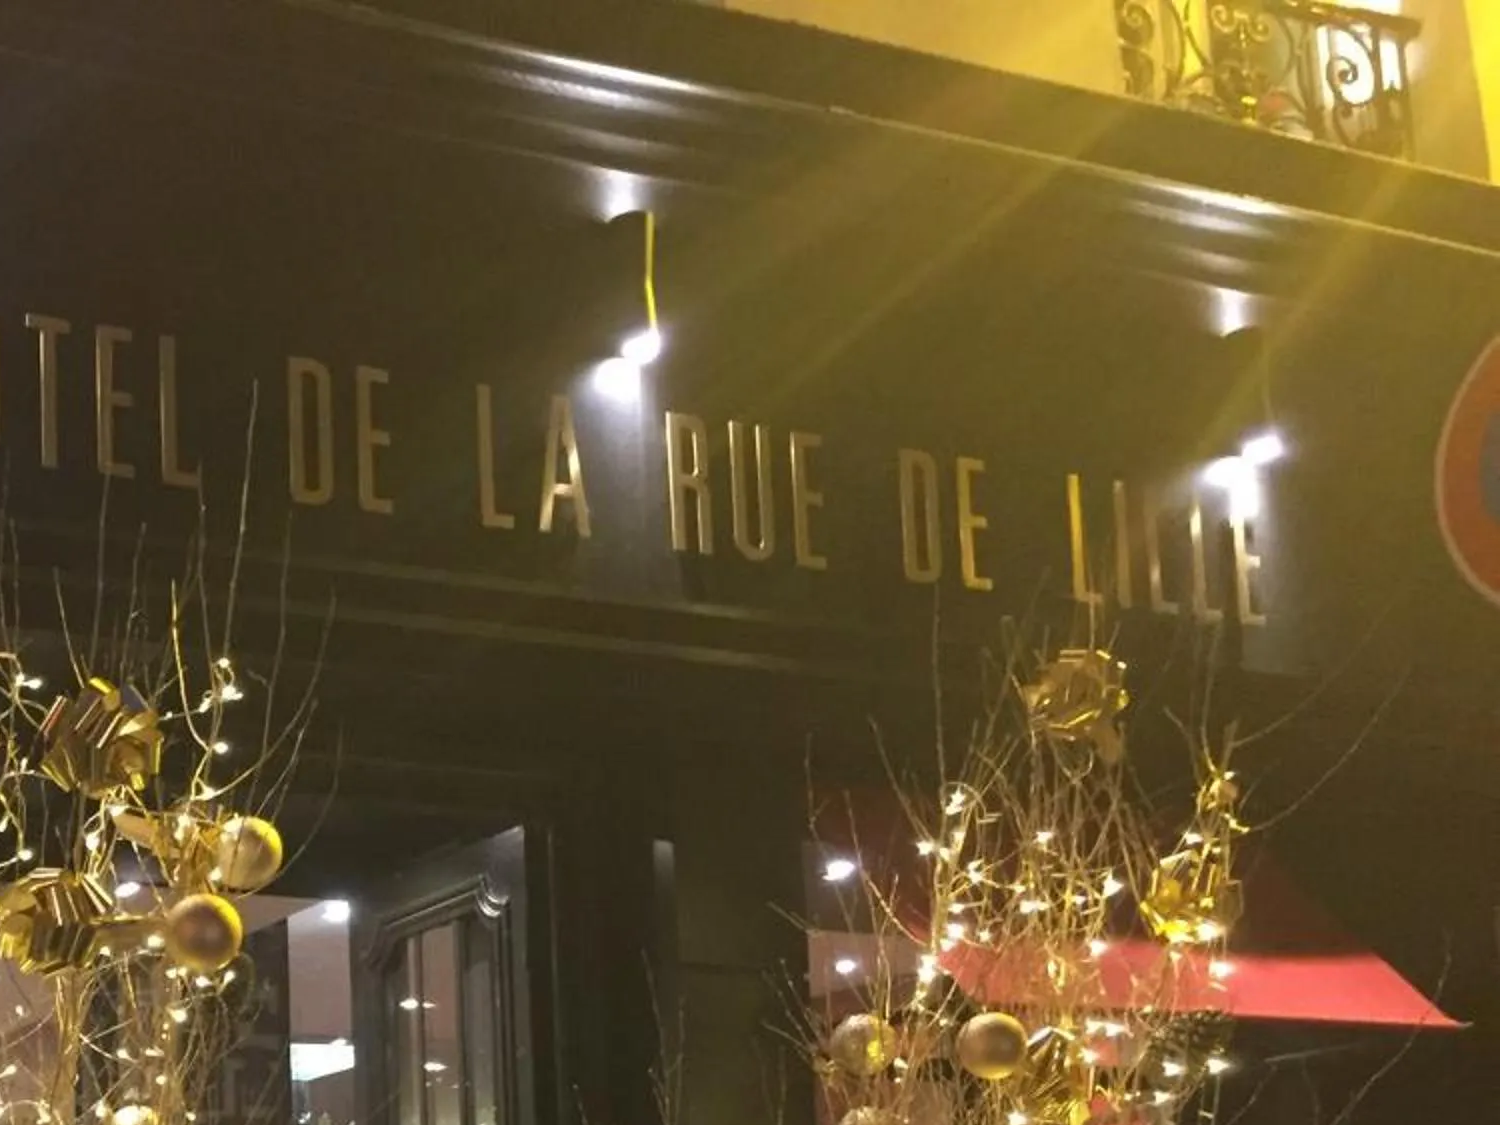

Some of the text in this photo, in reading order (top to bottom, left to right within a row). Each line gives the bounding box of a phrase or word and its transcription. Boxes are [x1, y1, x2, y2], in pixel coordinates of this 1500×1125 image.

[286, 356, 394, 514] DE
[475, 383, 592, 538] LA
[665, 410, 829, 570] RUE
[901, 448, 994, 591] DE
[1066, 472, 1268, 625] LILLE
